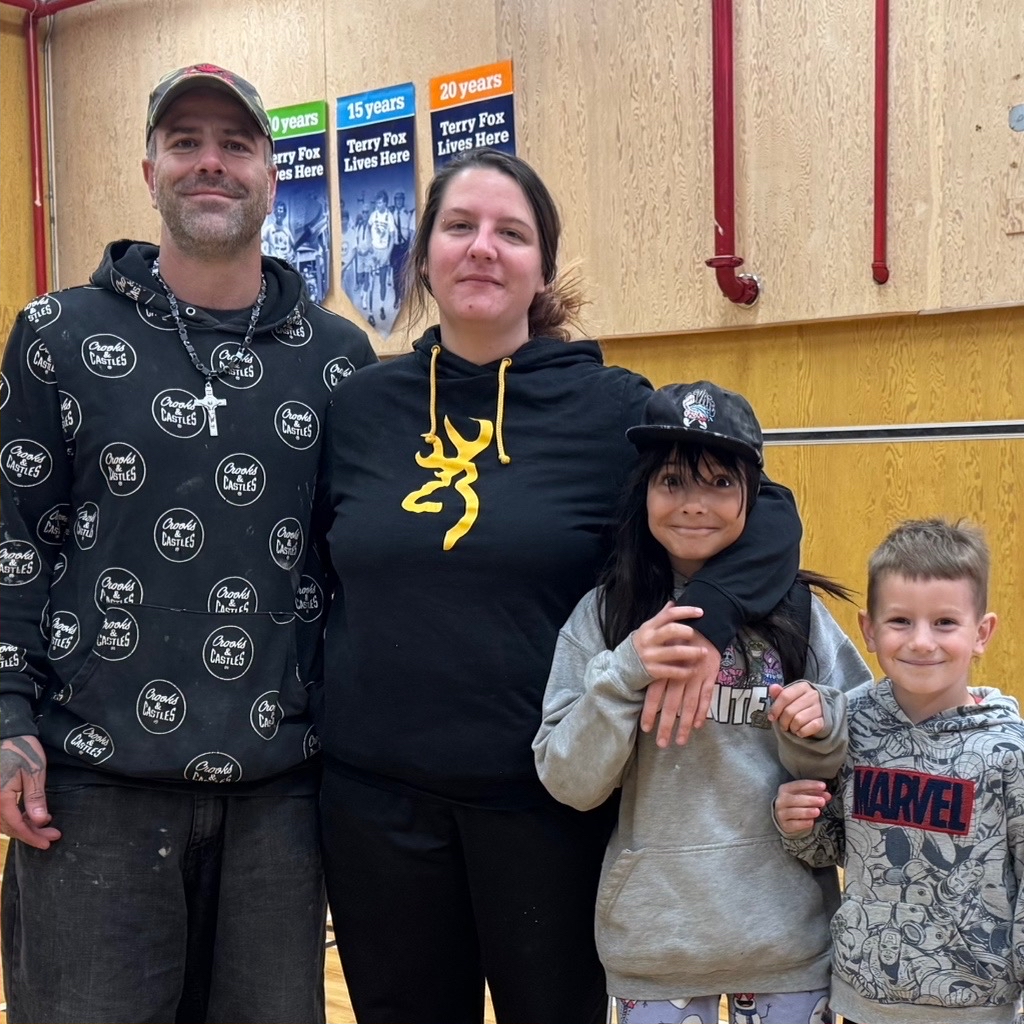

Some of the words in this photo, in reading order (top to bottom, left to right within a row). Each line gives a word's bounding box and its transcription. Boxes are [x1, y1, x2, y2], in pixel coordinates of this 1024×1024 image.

[439, 81, 457, 101] 20
[458, 73, 503, 99] years
[347, 101, 364, 120] 15
[364, 96, 405, 120] years
[269, 115, 280, 132] 0
[280, 112, 319, 134] years
[439, 117, 476, 137] Terry
[478, 111, 506, 128] Fox
[346, 137, 381, 153] Terry
[382, 131, 407, 148] Fox
[437, 138, 473, 156] Lives
[475, 130, 510, 147] Here
[272, 150, 296, 165] erry
[297, 147, 322, 161] Fox
[343, 155, 378, 172] Lives
[379, 149, 411, 167] Here
[294, 164, 324, 179] Here
[88, 341, 125, 352] Crooks
[89, 351, 127, 366] CASTLES
[103, 351, 112, 359] &
[160, 396, 196, 410] Crooks
[160, 407, 196, 426] CASTLES
[175, 408, 183, 416] &
[281, 408, 312, 422] Crooks
[282, 419, 312, 437] CASTLES
[294, 420, 300, 428] &
[10, 445, 46, 463] Crooks
[105, 452, 136, 465] Crooks
[6, 454, 41, 478] CASTLES
[115, 464, 122, 472] &
[223, 462, 258, 476] Crooks
[223, 475, 257, 492] CASTLES
[162, 517, 196, 531] Crooks
[161, 531, 195, 548] CASTLES
[174, 529, 182, 538] &
[8, 559, 17, 567] &
[101, 576, 136, 591] Crooks
[112, 590, 121, 599] &
[216, 586, 251, 600] Crooks
[228, 599, 236, 607] &
[109, 629, 118, 637] &
[212, 635, 247, 650] Crooks
[210, 648, 244, 666] CASTLES
[224, 648, 231, 656] &
[145, 688, 179, 705] Crooks
[142, 700, 176, 722] CASTLES
[154, 702, 162, 710] &
[82, 727, 110, 746] Crooks
[70, 733, 106, 757] CASTLES
[195, 761, 234, 775] Crooks
[853, 768, 968, 832] MARVEL
